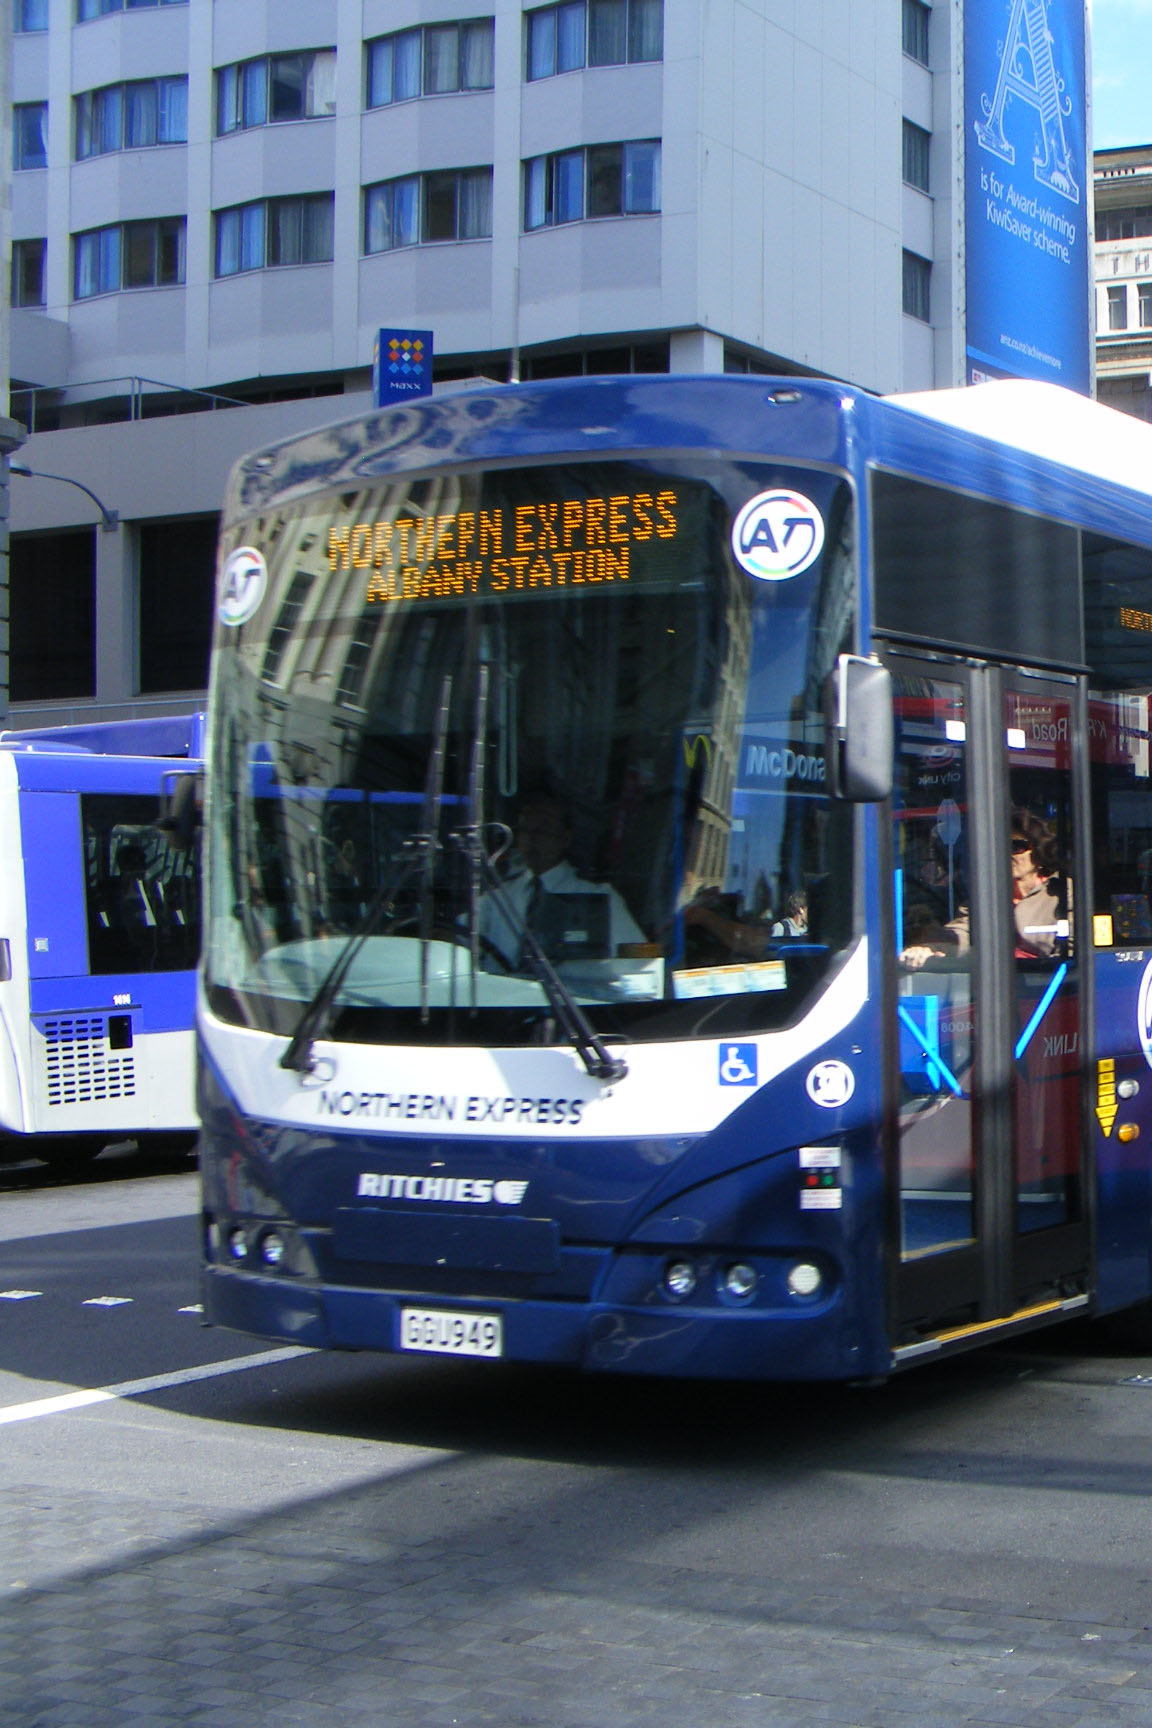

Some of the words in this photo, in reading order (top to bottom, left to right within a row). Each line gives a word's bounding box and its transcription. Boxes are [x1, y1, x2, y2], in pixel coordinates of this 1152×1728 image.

[981, 167, 989, 192] is
[990, 172, 1005, 200] for
[1006, 184, 1076, 246] Award-winning
[986, 199, 1032, 243] KiwiSaver
[1033, 229, 1071, 265] scheme.
[328, 509, 503, 572] NORTHERN
[514, 490, 677, 553] EXPRESS
[367, 560, 484, 602] ALBANY
[490, 546, 631, 591] STATION
[318, 1090, 455, 1121] NORTHERN
[465, 1096, 584, 1125] EXPRESS
[358, 1173, 494, 1204] RITCHIES
[407, 1315, 499, 1351] GGU949
